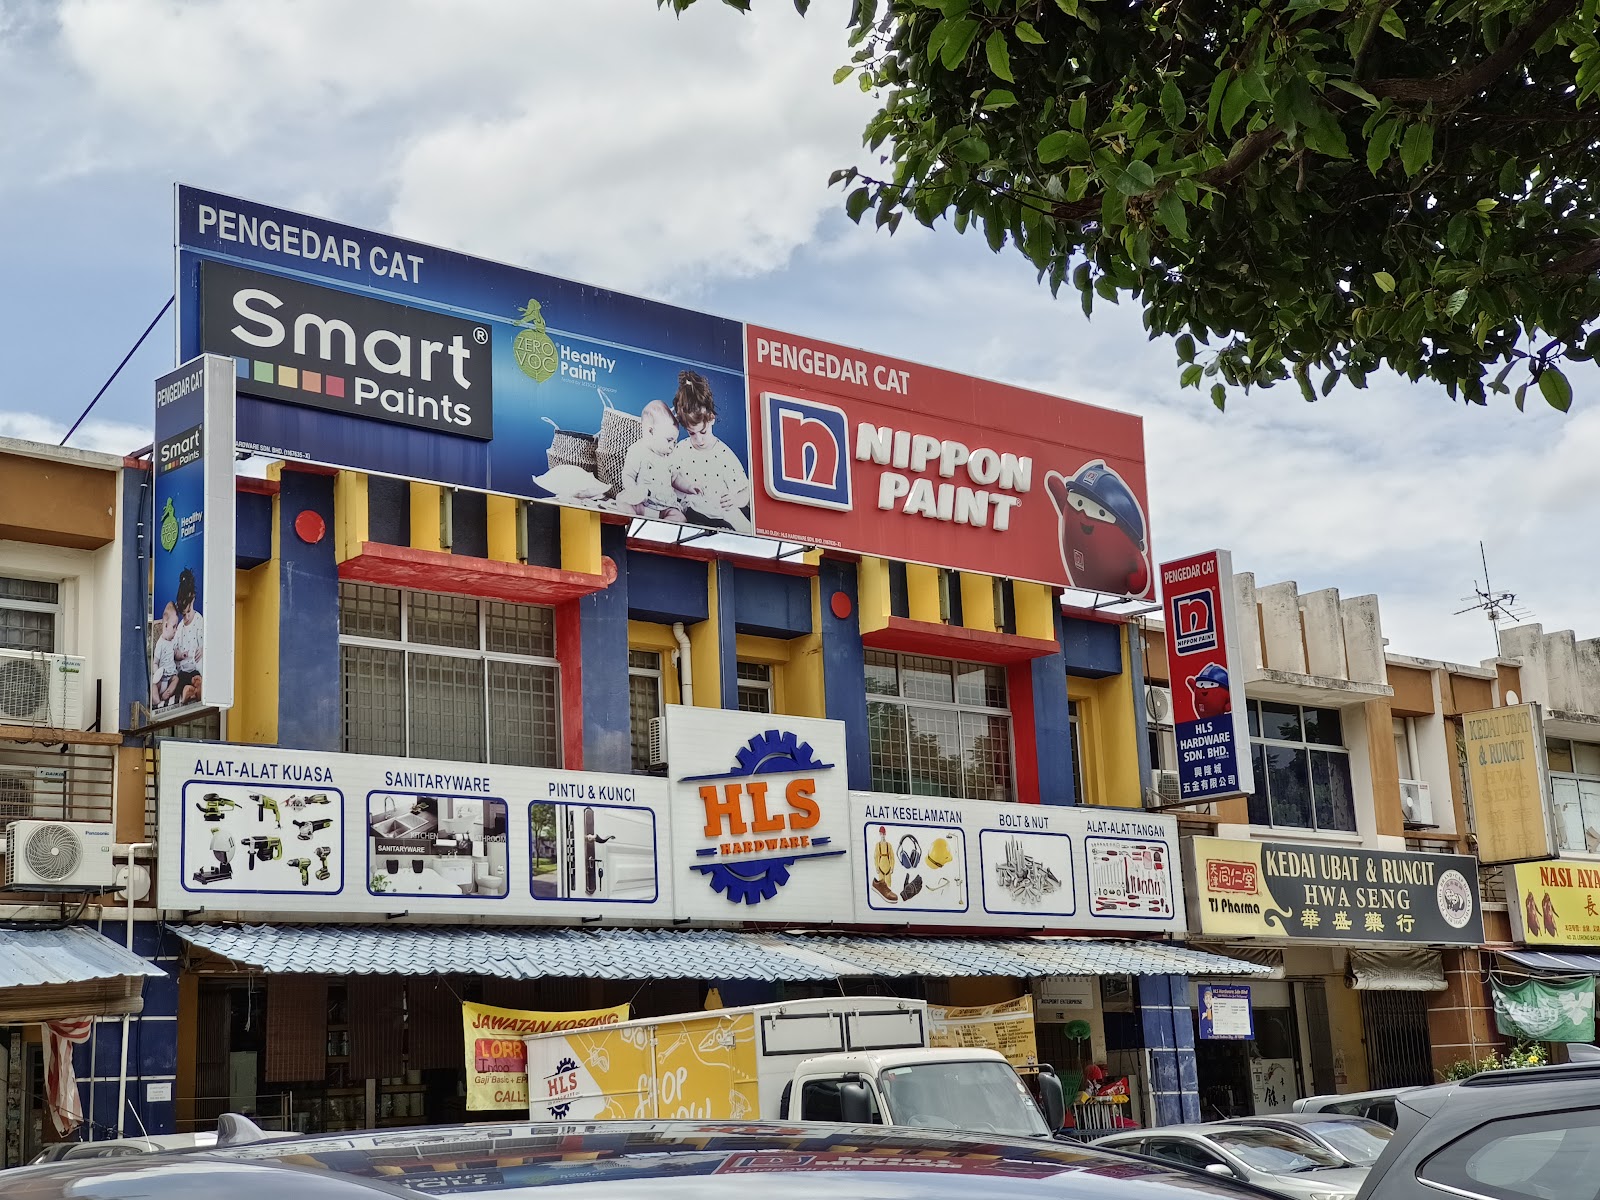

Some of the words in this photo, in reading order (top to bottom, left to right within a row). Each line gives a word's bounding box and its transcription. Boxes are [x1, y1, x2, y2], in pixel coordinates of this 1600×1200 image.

[198, 204, 361, 270] PENGEDAR
[369, 246, 424, 284] CAT
[231, 288, 472, 390] Smart
[518, 336, 554, 357] ZERO
[515, 350, 555, 373] VOC
[560, 344, 616, 374] Healthy
[756, 338, 868, 387] PENGEDAR
[874, 365, 910, 395] CAT
[560, 361, 597, 382] Paint
[156, 377, 190, 408] PENGEDAR
[191, 368, 204, 392] CAT
[354, 376, 472, 426] Paints
[161, 430, 200, 462] Smart
[180, 450, 200, 466] Paints
[856, 422, 1033, 492] NIPPON
[878, 471, 1018, 532] PAINT
[162, 521, 176, 535] ZERO
[180, 510, 203, 530] Healthy
[180, 523, 196, 538] Paint
[1164, 564, 1200, 584] PENGEDAR
[1202, 560, 1215, 574] CAT
[1178, 637, 1198, 647] NIPPON
[1198, 633, 1214, 642] PAINT
[1196, 722, 1213, 734] HLS
[1469, 716, 1500, 740] KEDAI
[1503, 712, 1529, 736] UBAT
[1180, 732, 1230, 750] HARDWARE
[1184, 750, 1206, 762] SDN.
[1207, 746, 1229, 758] BHD.
[1479, 745, 1488, 766] &
[1489, 740, 1525, 764] RUNCIT
[194, 760, 278, 779] ALAT-ALAT
[283, 764, 333, 782] KUASA
[385, 772, 490, 792] SANITARYWARE
[549, 782, 584, 799] PINTU
[588, 787, 596, 799] &
[599, 787, 635, 802] KUNCI
[1183, 774, 1236, 793] 五金有限公司
[698, 778, 820, 838] HLS
[866, 805, 890, 818] ALAT
[893, 806, 962, 824] KESELAMATAN
[1000, 814, 1022, 827] BOLT
[1024, 816, 1030, 828] &
[1032, 816, 1048, 829] NUT
[1086, 820, 1128, 836] ALAT-ALAT
[1130, 824, 1165, 838] TANGAN
[410, 832, 438, 840] KITCHEN
[720, 836, 810, 855] HARDWARE
[378, 844, 425, 853] SANITARYWARE
[1266, 850, 1316, 879] KEDAI
[1320, 854, 1359, 882] UBAT
[1366, 858, 1377, 882] &
[1382, 858, 1434, 886] RUNCIT
[1540, 866, 1574, 888] NASI
[1208, 898, 1218, 912] TJ
[1222, 898, 1260, 914] Pharma
[1304, 884, 1352, 907] HWA
[1356, 886, 1411, 910] SENG
[1584, 894, 1598, 916] 長
[1300, 908, 1416, 933] 華盛藥行
[472, 1014, 552, 1033] JAWATAN
[553, 1013, 619, 1031] KOSONG
[475, 1076, 490, 1086] Gaji
[492, 1076, 510, 1084] Basic
[548, 1072, 578, 1097] HLS
[494, 1090, 526, 1102] CALL:
